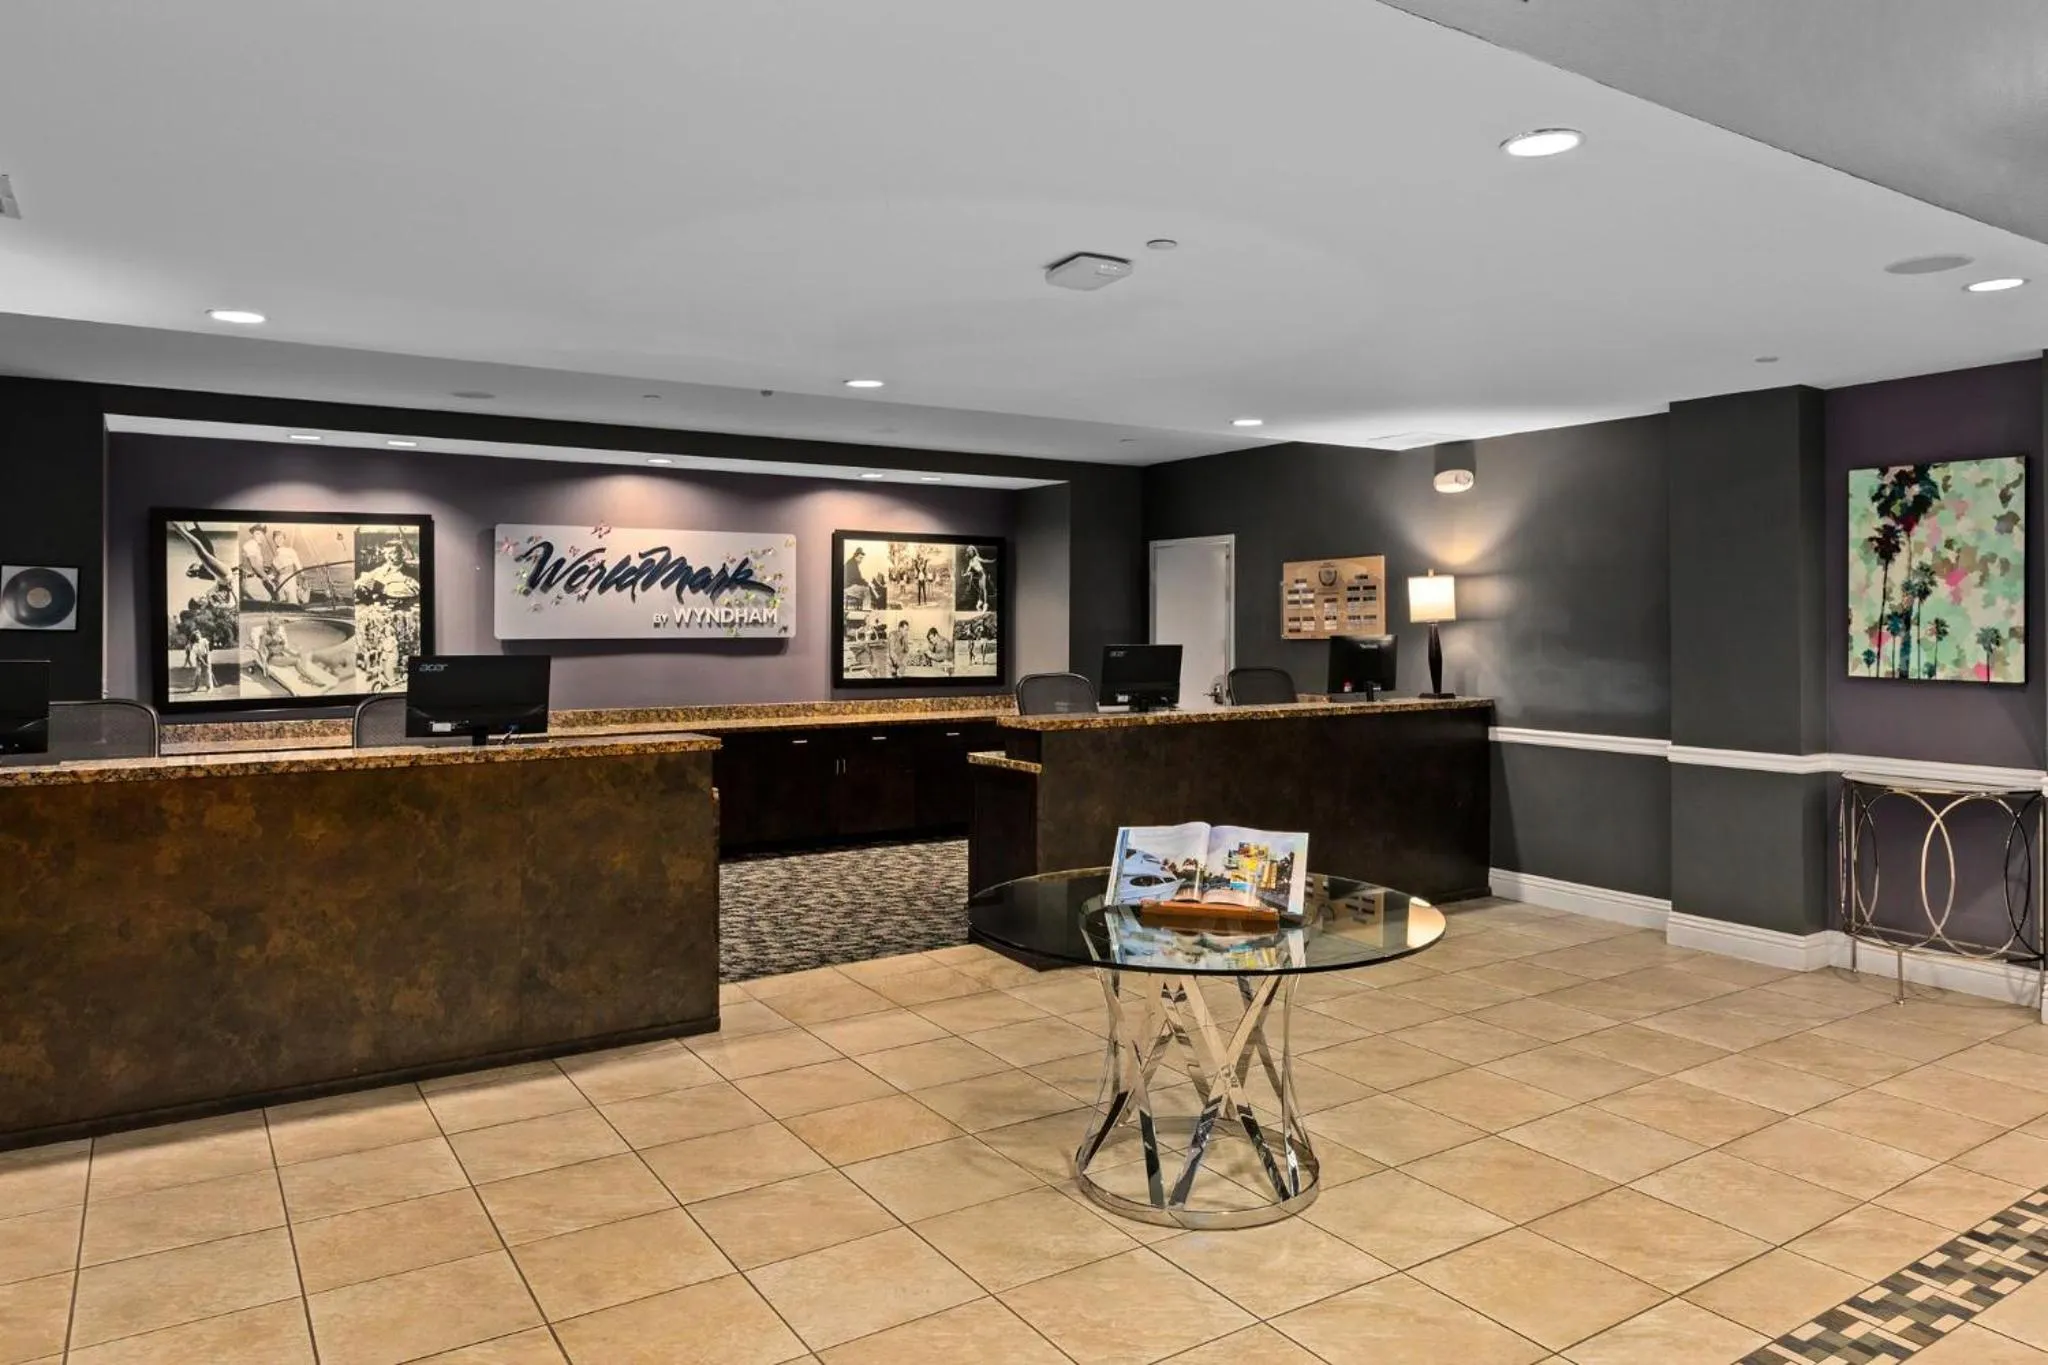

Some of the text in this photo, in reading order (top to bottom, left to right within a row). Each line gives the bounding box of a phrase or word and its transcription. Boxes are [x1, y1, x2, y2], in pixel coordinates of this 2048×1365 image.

[515, 541, 776, 604] WorldMark
[653, 606, 778, 626] BY WYNDHAM
[418, 663, 449, 672] acer
